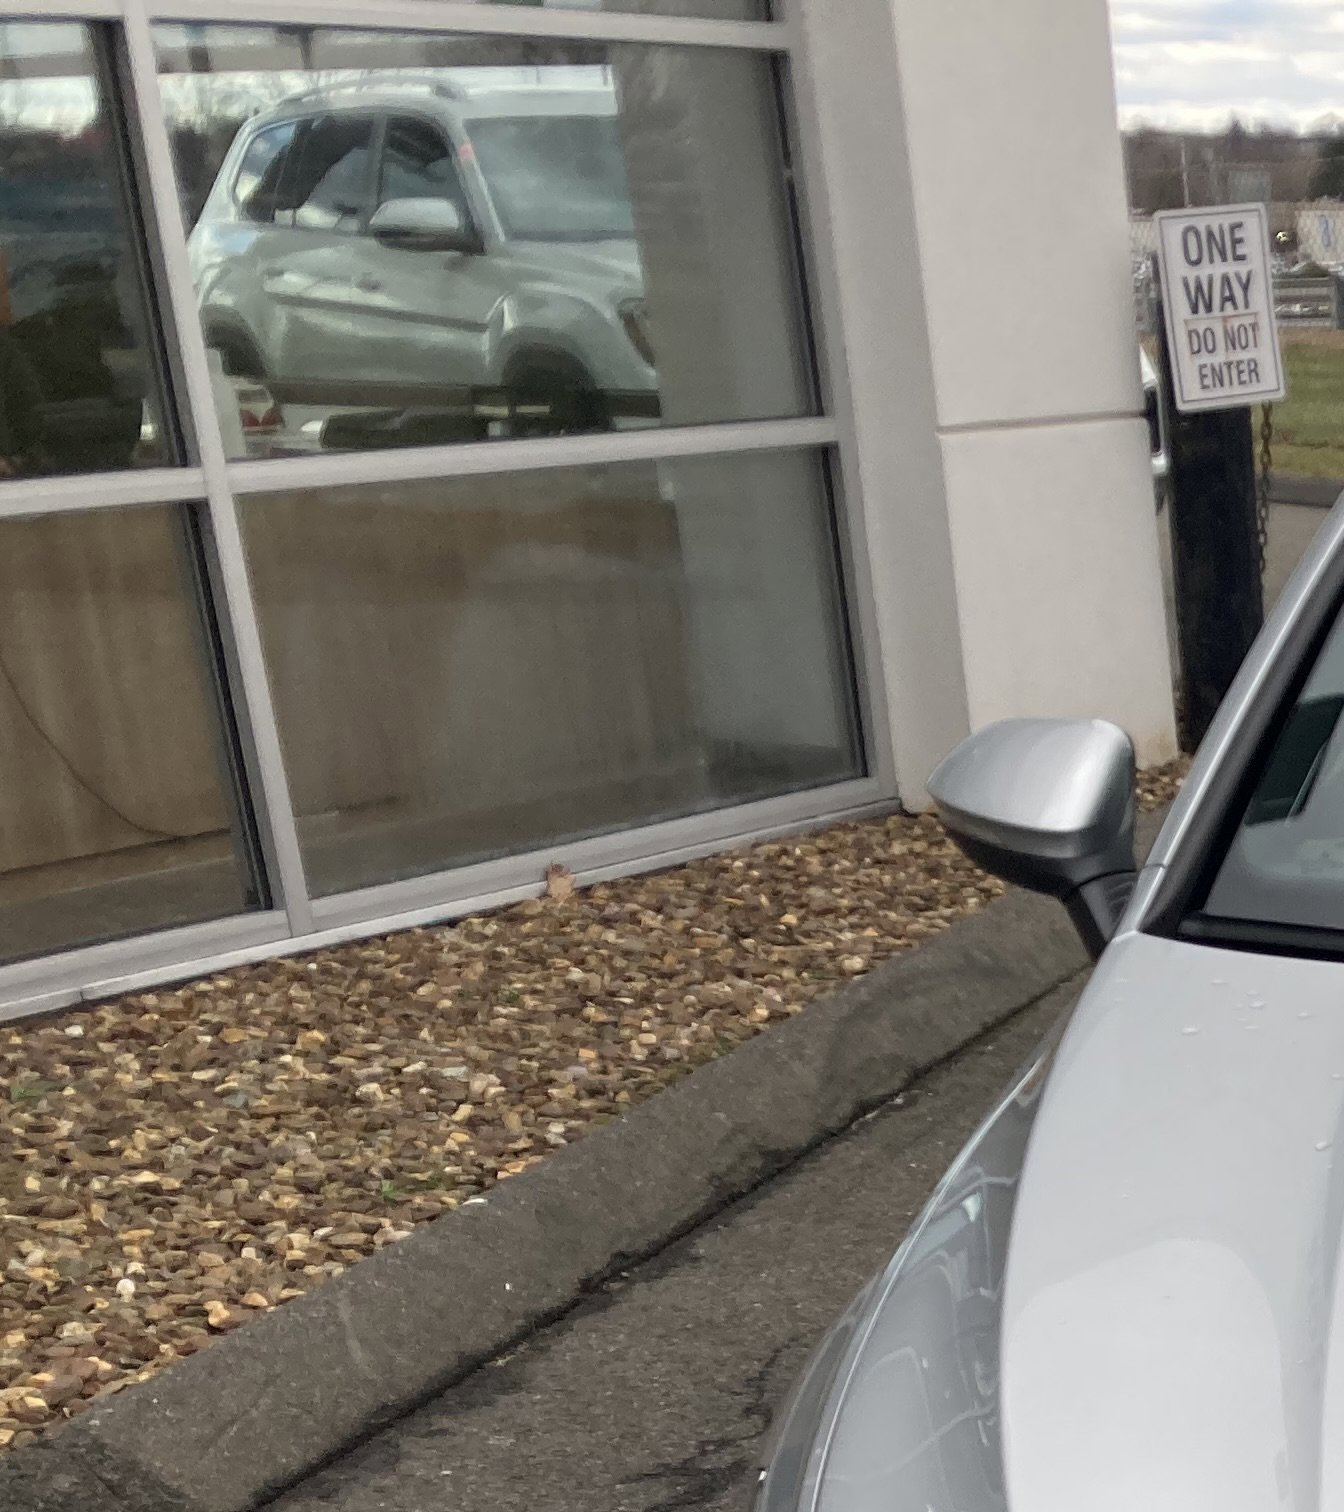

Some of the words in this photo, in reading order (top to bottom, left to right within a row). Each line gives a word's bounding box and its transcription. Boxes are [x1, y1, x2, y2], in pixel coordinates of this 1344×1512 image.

[1181, 221, 1248, 267] ONE
[1182, 269, 1253, 315] WAY
[1188, 326, 1217, 356] DO
[1223, 321, 1259, 352] NOT
[1199, 358, 1261, 390] ENTER
